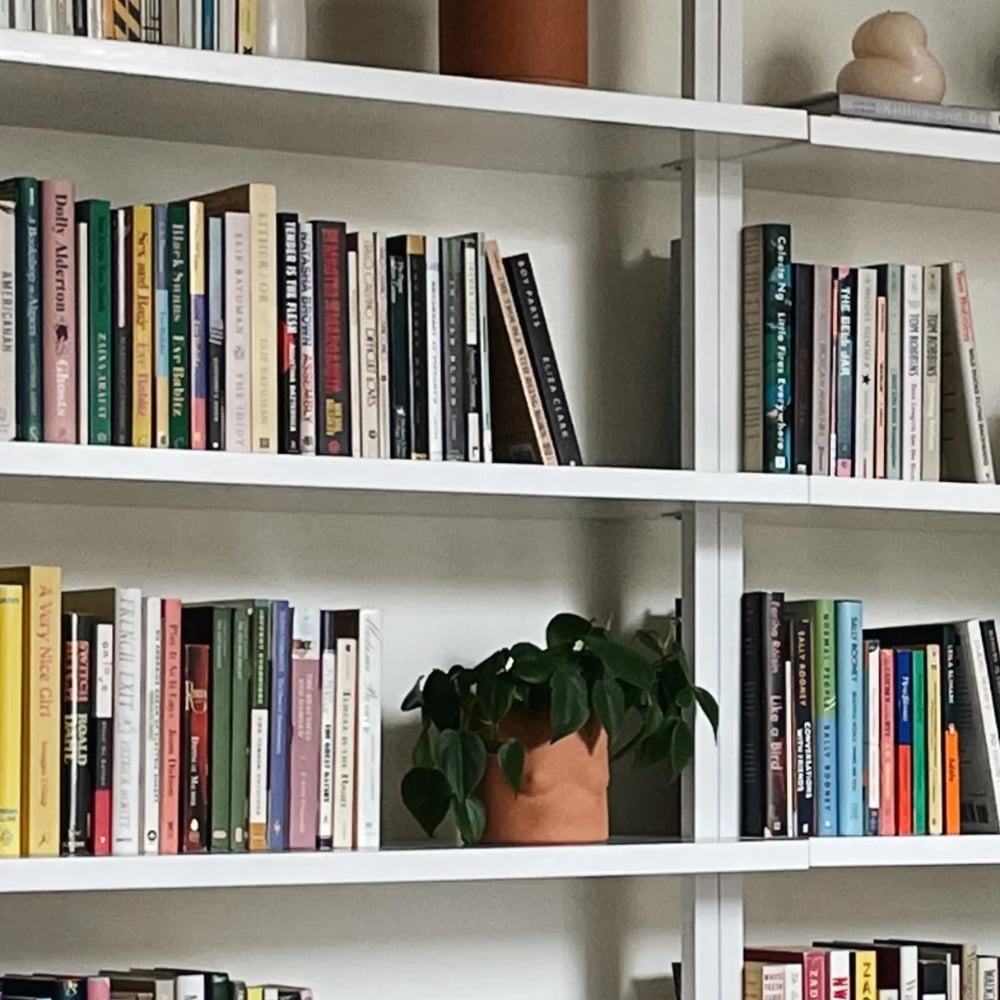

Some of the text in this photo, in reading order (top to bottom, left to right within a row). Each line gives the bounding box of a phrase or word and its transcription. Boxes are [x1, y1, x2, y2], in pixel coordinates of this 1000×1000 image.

[52, 193, 68, 313] Dolly Alderton
[135, 231, 149, 331] Sex and Rage
[171, 223, 184, 323] Black Swans
[286, 221, 298, 334] TENDER IS THE FLESH
[301, 231, 312, 346] NATASHA BROWN
[775, 235, 787, 301] Celeste Ng
[2, 271, 13, 352] AMERICANAH
[235, 268, 245, 334] BATUMAN
[517, 260, 541, 328] BOY PARTS
[840, 287, 851, 376] THE BELL JAR
[926, 313, 937, 334] TOM
[137, 342, 149, 417] Eve Babitz
[172, 335, 185, 417] Eve Babitz
[774, 311, 787, 450] Little Fires Everywhere
[909, 313, 919, 377] TOM ROBBINS
[926, 336, 938, 377] ROBBINS
[56, 359, 69, 417] Ghosts
[303, 353, 314, 424] ASSEMBLY
[542, 356, 570, 439] ELIZA CLARK
[37, 584, 52, 718] A Very Nice Girl
[78, 640, 89, 703] SWITCH
[119, 598, 137, 711] FRENCH EXIT
[798, 630, 808, 707] SALLY ROONEY
[823, 613, 831, 661] NORMAL
[850, 616, 859, 682] SALLY ROONEY
[64, 713, 75, 764] DAHL
[77, 713, 88, 766] ROALD
[771, 695, 783, 771] Like a Bird
[796, 729, 805, 792] WITH FRIENDS
[804, 721, 813, 799] CONVERSATIONS
[823, 725, 832, 812] SALLY ROONEY
[833, 977, 849, 1000] NW
